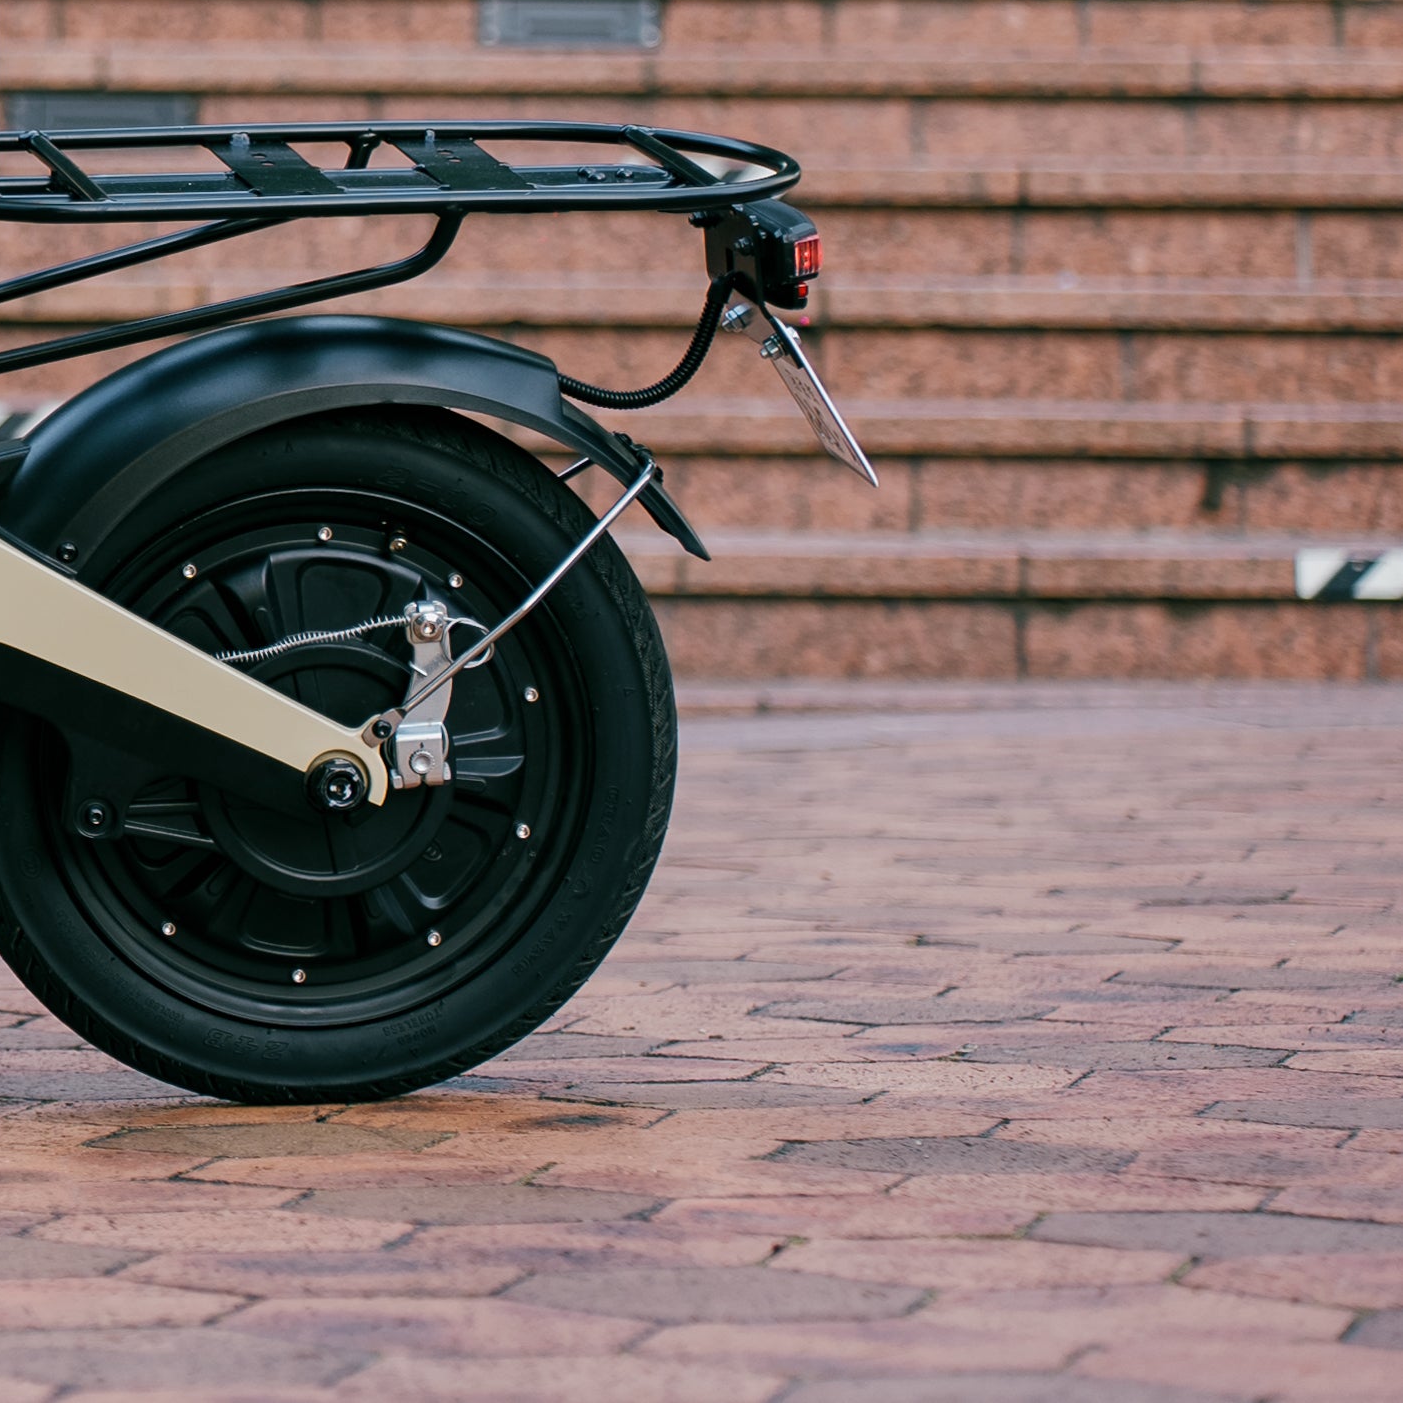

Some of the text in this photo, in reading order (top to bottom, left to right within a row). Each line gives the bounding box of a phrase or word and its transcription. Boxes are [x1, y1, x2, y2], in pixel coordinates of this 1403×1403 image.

[591, 784, 620, 865] CHAO
[381, 1007, 443, 1037] TUBELESS
[396, 1023, 438, 1046] MOPED
[203, 1027, 290, 1061] 24B
